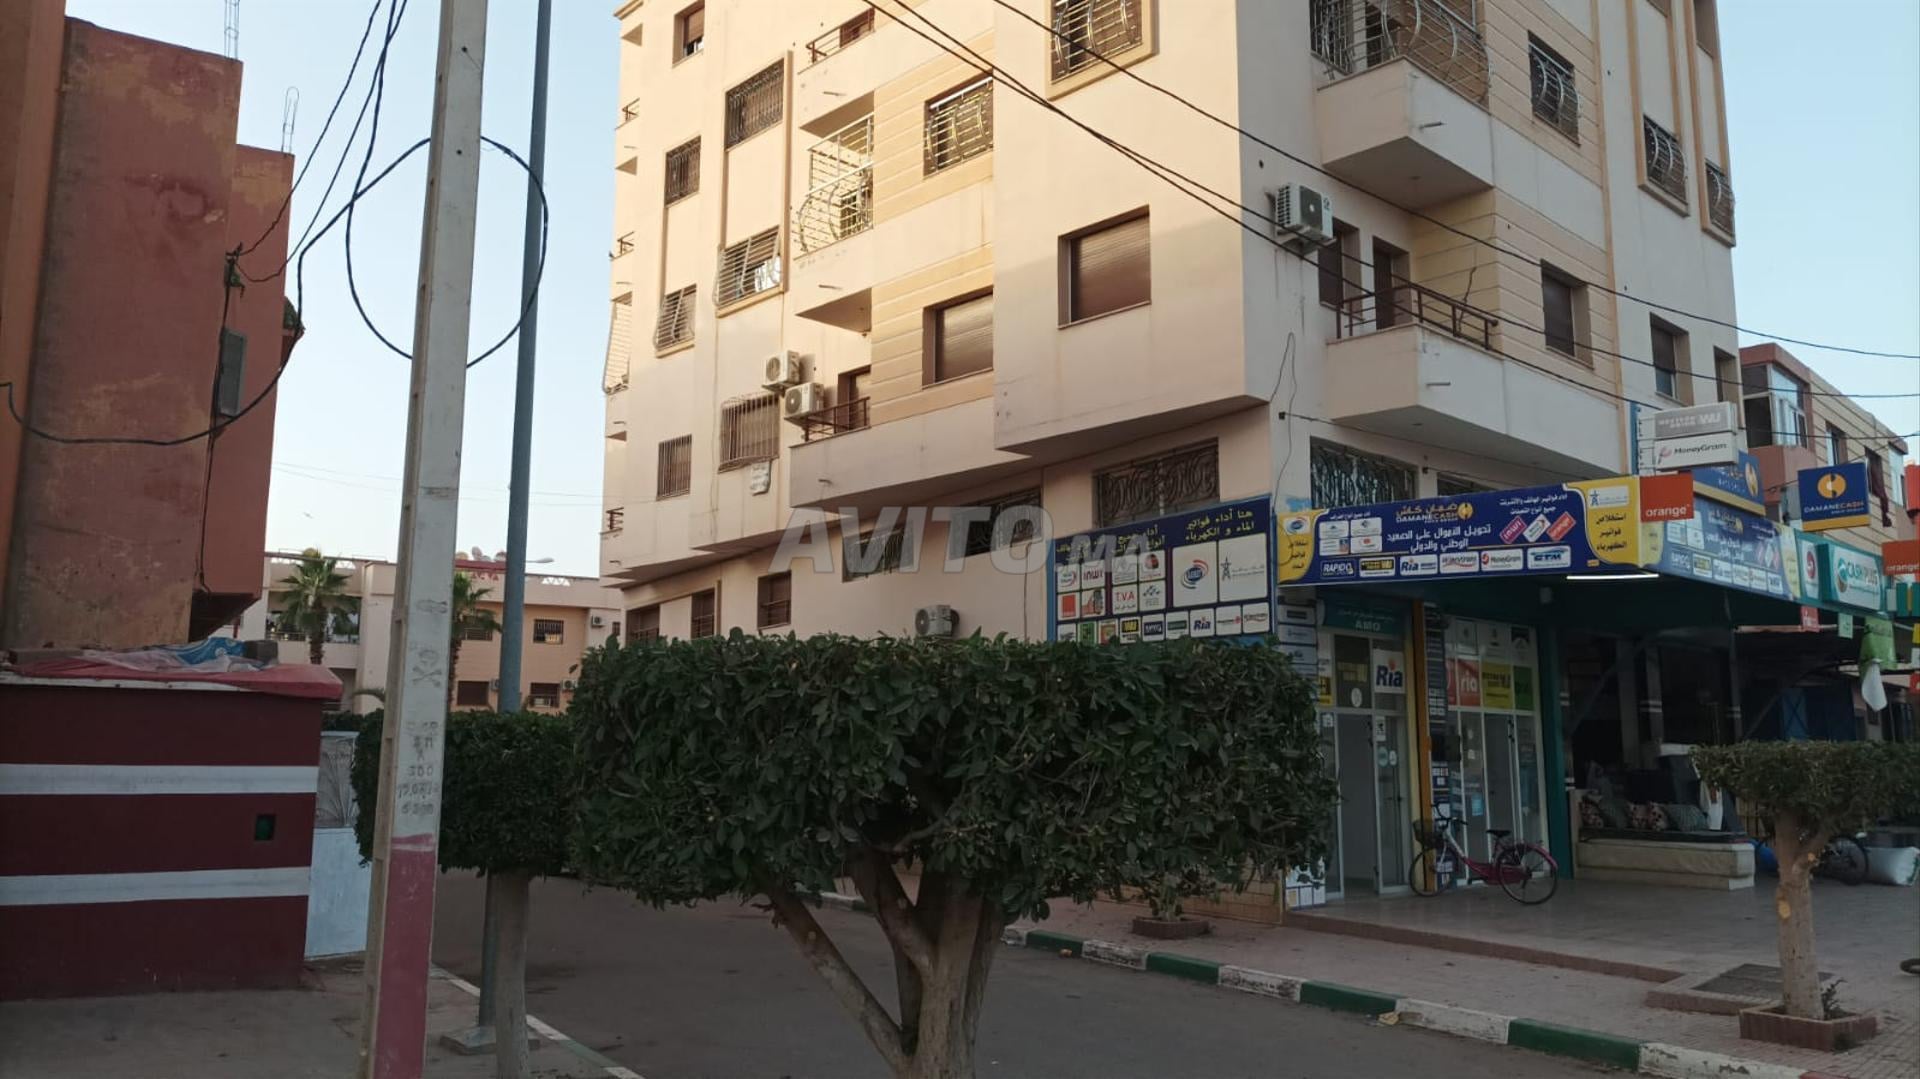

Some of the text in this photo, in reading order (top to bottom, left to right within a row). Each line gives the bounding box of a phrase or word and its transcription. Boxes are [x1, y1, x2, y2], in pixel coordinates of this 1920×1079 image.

[1674, 444, 1727, 453] MoneyGram
[1645, 506, 1687, 517] orange
[1804, 501, 1864, 513] DAMANECASH
[1237, 509, 1254, 520] هنا
[1401, 560, 1419, 571] Ria
[1193, 618, 1211, 631] Ria
[1376, 658, 1403, 687] Ria
